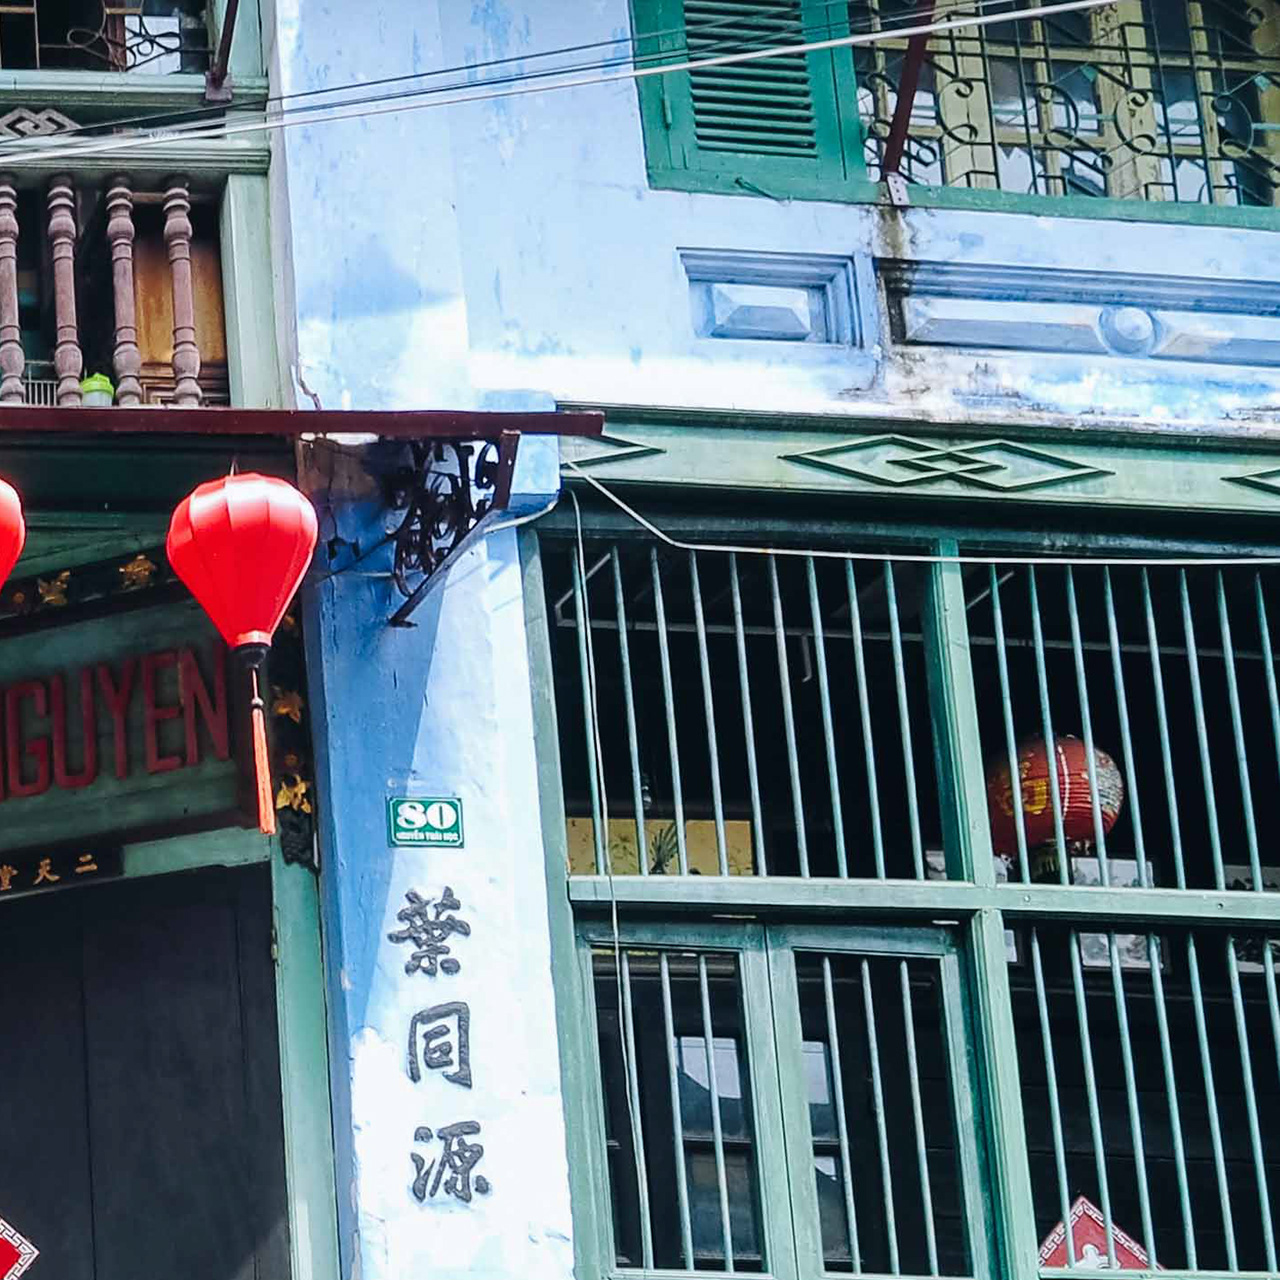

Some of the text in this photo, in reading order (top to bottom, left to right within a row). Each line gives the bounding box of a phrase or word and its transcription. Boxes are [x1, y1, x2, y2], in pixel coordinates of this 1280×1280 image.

[396, 801, 457, 829] 80
[387, 885, 491, 1203] 葉同源
